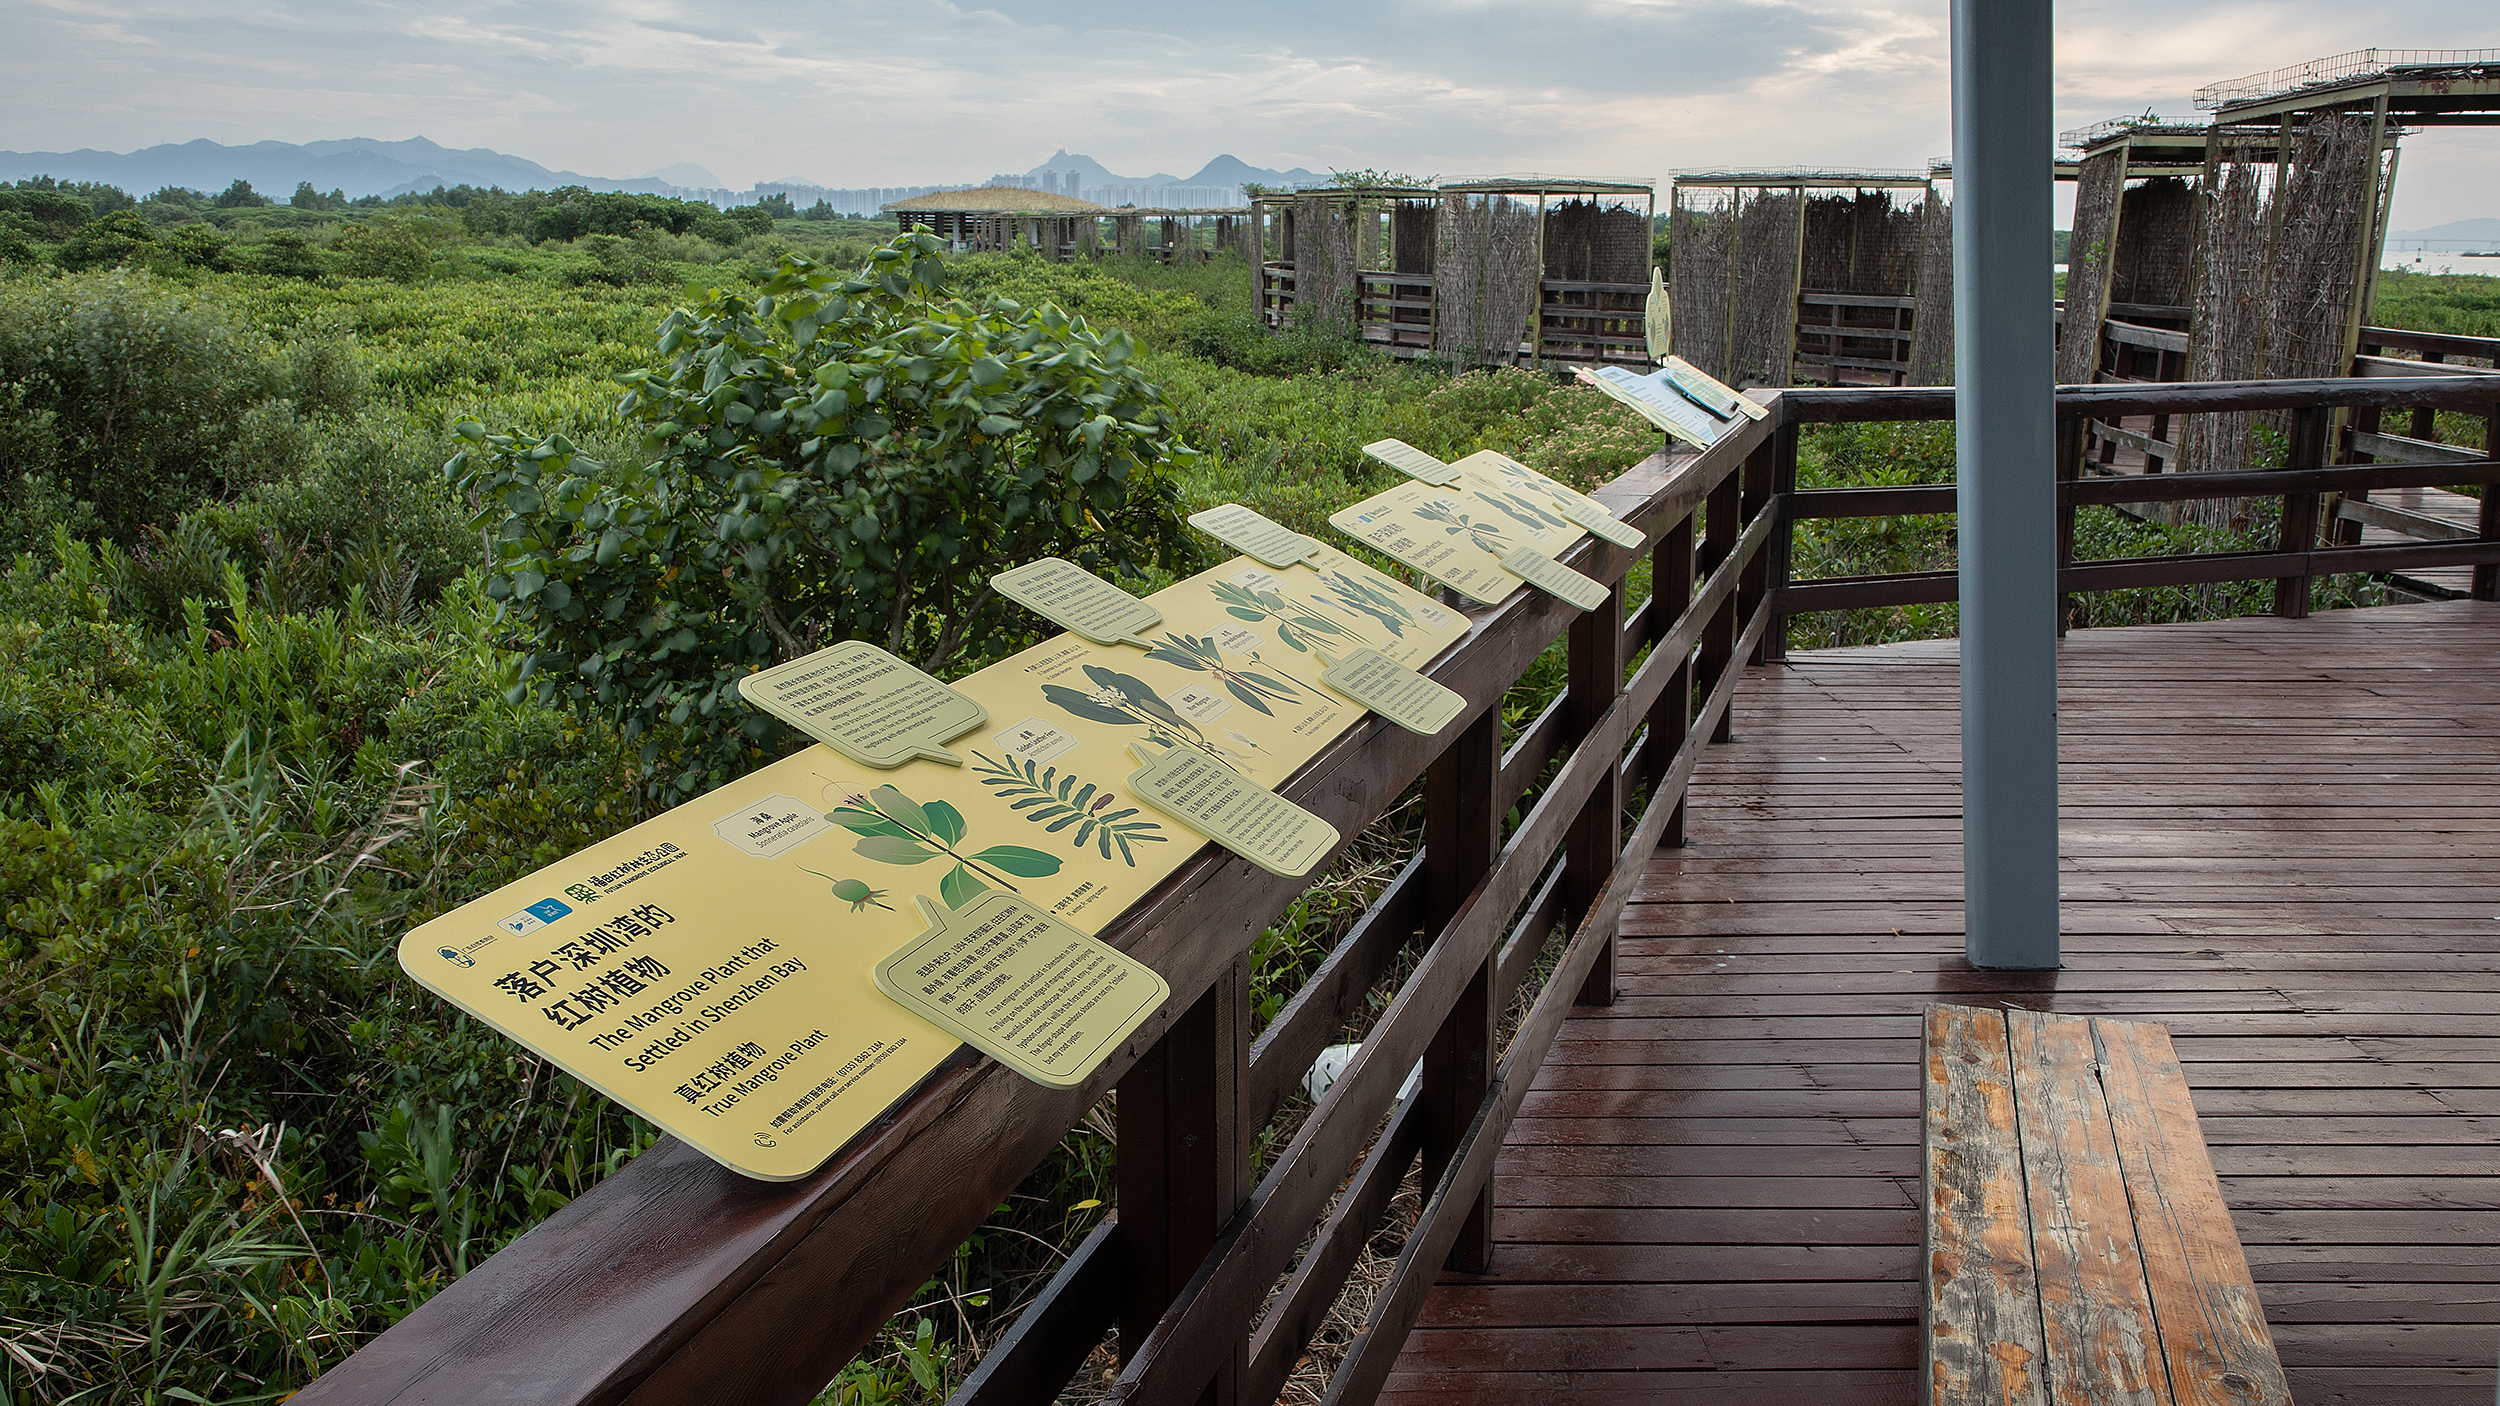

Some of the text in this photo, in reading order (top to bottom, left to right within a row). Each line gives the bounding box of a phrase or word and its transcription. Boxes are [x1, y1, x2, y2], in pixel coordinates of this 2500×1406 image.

[1414, 548, 1432, 558] Mangrove
[1421, 558, 1437, 569] Settled
[1434, 551, 1451, 561] Shenzhen
[1016, 730, 1057, 752] Golden Leather Fern
[748, 813, 799, 839] Mangrove Apple
[750, 812, 777, 825] 海桑
[756, 817, 815, 848] Sonneratia caseolaris
[587, 842, 680, 888] 福田红树林生态公园
[604, 851, 689, 895] FUTIAN MANGROVE ECOLOGICAL PARK
[1085, 894, 1099, 903] spring
[1095, 885, 1109, 896] summer
[493, 904, 676, 1003] 落户深圳湾的
[1000, 989, 1022, 1006] emigrant
[1019, 981, 1030, 991] and
[1027, 970, 1044, 985] settled
[1044, 953, 1067, 970] Shenzhen
[1067, 942, 1081, 952] 1994.
[541, 955, 671, 1032] 红树植物
[588, 938, 780, 1051] The Mangrove Plant that
[624, 957, 807, 1072] Settled in Shenzhen Bay
[995, 1015, 1014, 1027] living
[1014, 1005, 1026, 1013] the
[1022, 996, 1036, 1007] outer
[1033, 986, 1048, 998] edges
[1048, 966, 1072, 985] mangroves
[1068, 960, 1079, 969] and
[1076, 948, 1095, 963] enjoying
[1001, 1022, 1026, 1041] beautiful
[1022, 1009, 1042, 1025] sea-side
[1037, 993, 1063, 1011] landscape.
[1058, 985, 1070, 994] But
[1086, 961, 1100, 971] when
[1016, 1032, 1038, 1049] typhoon
[1034, 1021, 1053, 1034] comes,
[1050, 1011, 1061, 1020] will
[1062, 1002, 1073, 1010] the
[1068, 995, 1081, 1004] first
[1077, 989, 1088, 997] one
[1088, 978, 1100, 988] rush
[1094, 972, 1107, 980] into
[1029, 1048, 1043, 1056] The
[1037, 1027, 1066, 1050] finger-shape
[1061, 1011, 1084, 1029] bamboos
[1080, 1001, 1096, 1014] shoots
[1092, 995, 1102, 1003] are
[1098, 989, 1108, 997] not
[1042, 1056, 1056, 1065] but
[1058, 1042, 1071, 1053] root
[1067, 1031, 1084, 1045] system.
[673, 1041, 767, 1105] 真红树植物
[701, 1029, 829, 1117] True Mangrove Plant
[783, 1127, 794, 1136] For
[792, 1110, 820, 1129] assistance,
[815, 1098, 832, 1112] please
[829, 1091, 840, 1100] call
[844, 1075, 861, 1088] service
[858, 1063, 876, 1077] number
[895, 1038, 908, 1047] 2184
[836, 1061, 859, 1078] (0755)
[854, 1051, 872, 1064] 8362
[868, 1041, 885, 1053] 2184
